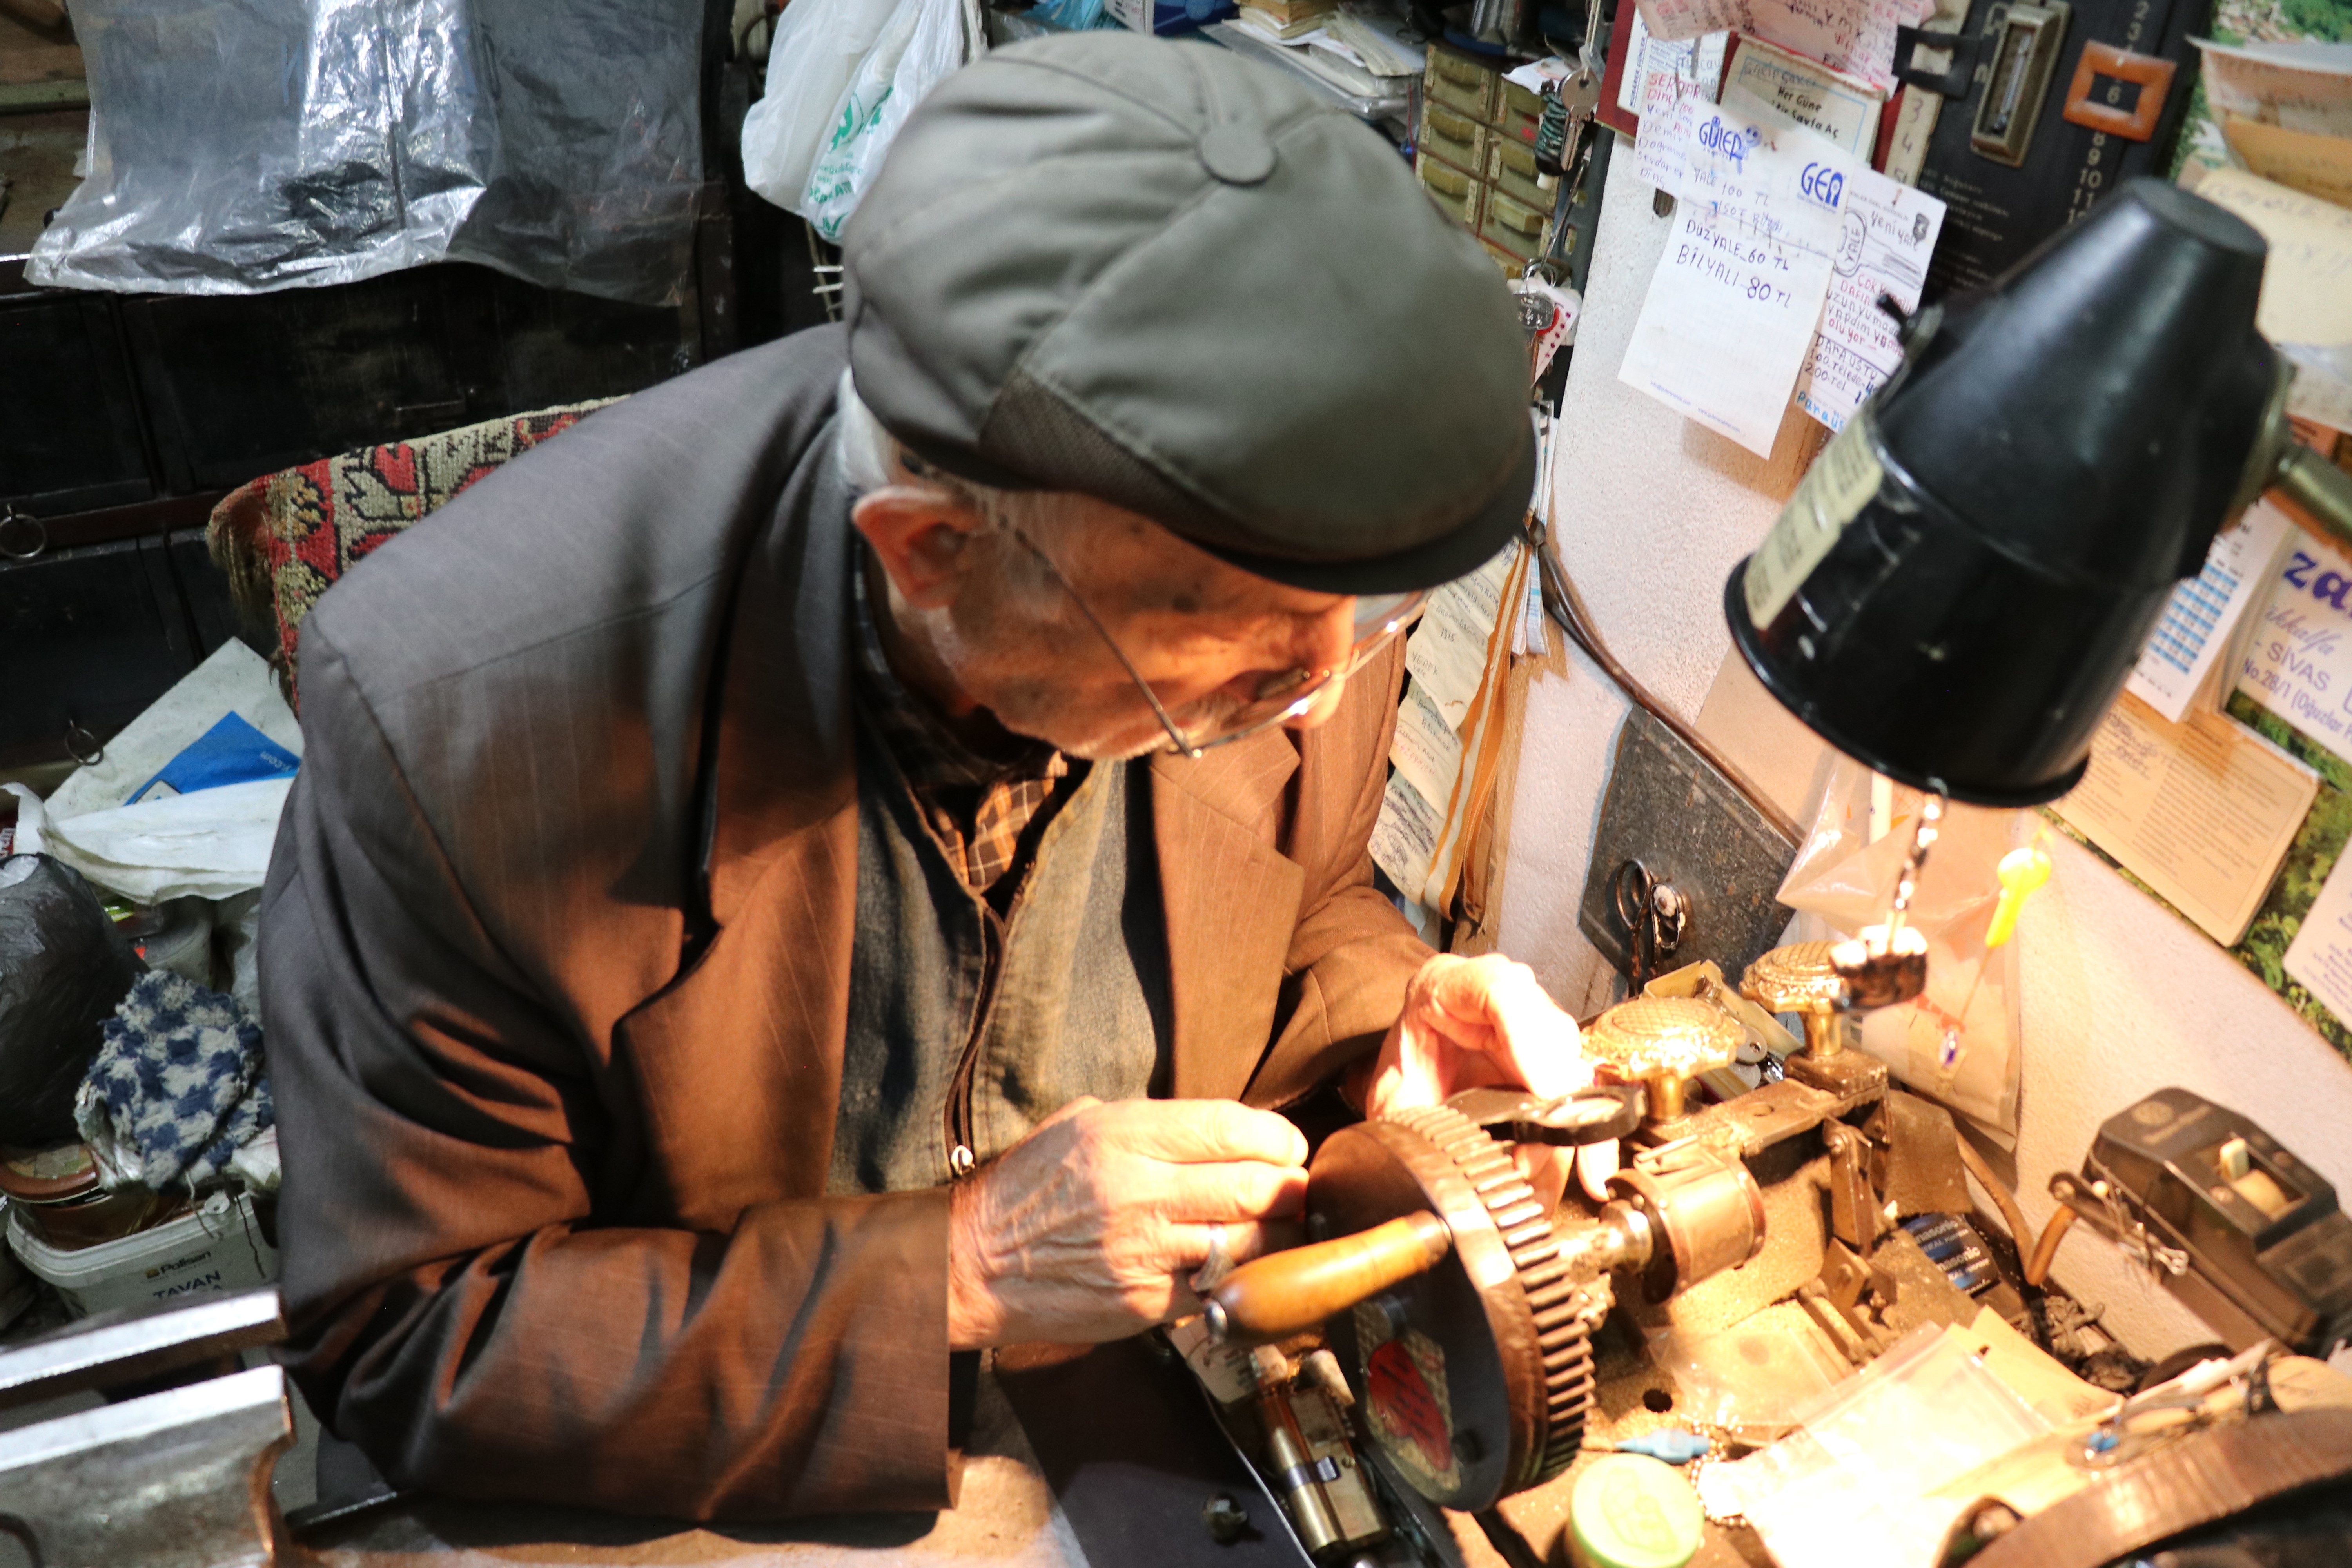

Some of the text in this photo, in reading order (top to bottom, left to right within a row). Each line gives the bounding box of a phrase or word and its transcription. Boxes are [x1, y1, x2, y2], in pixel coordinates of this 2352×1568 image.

[1778, 87, 1822, 111] Her Güne
[2107, 85, 2121, 104] 6
[2079, 168, 2102, 188] 10
[1722, 182, 1742, 198] 100
[1845, 228, 1860, 262] YALE
[1773, 256, 1788, 271] TL
[1747, 276, 1771, 301] 80
[2267, 641, 2331, 691] SIVAS
[160, 1251, 211, 1274] Polisan
[152, 1270, 221, 1299] TAVAN
